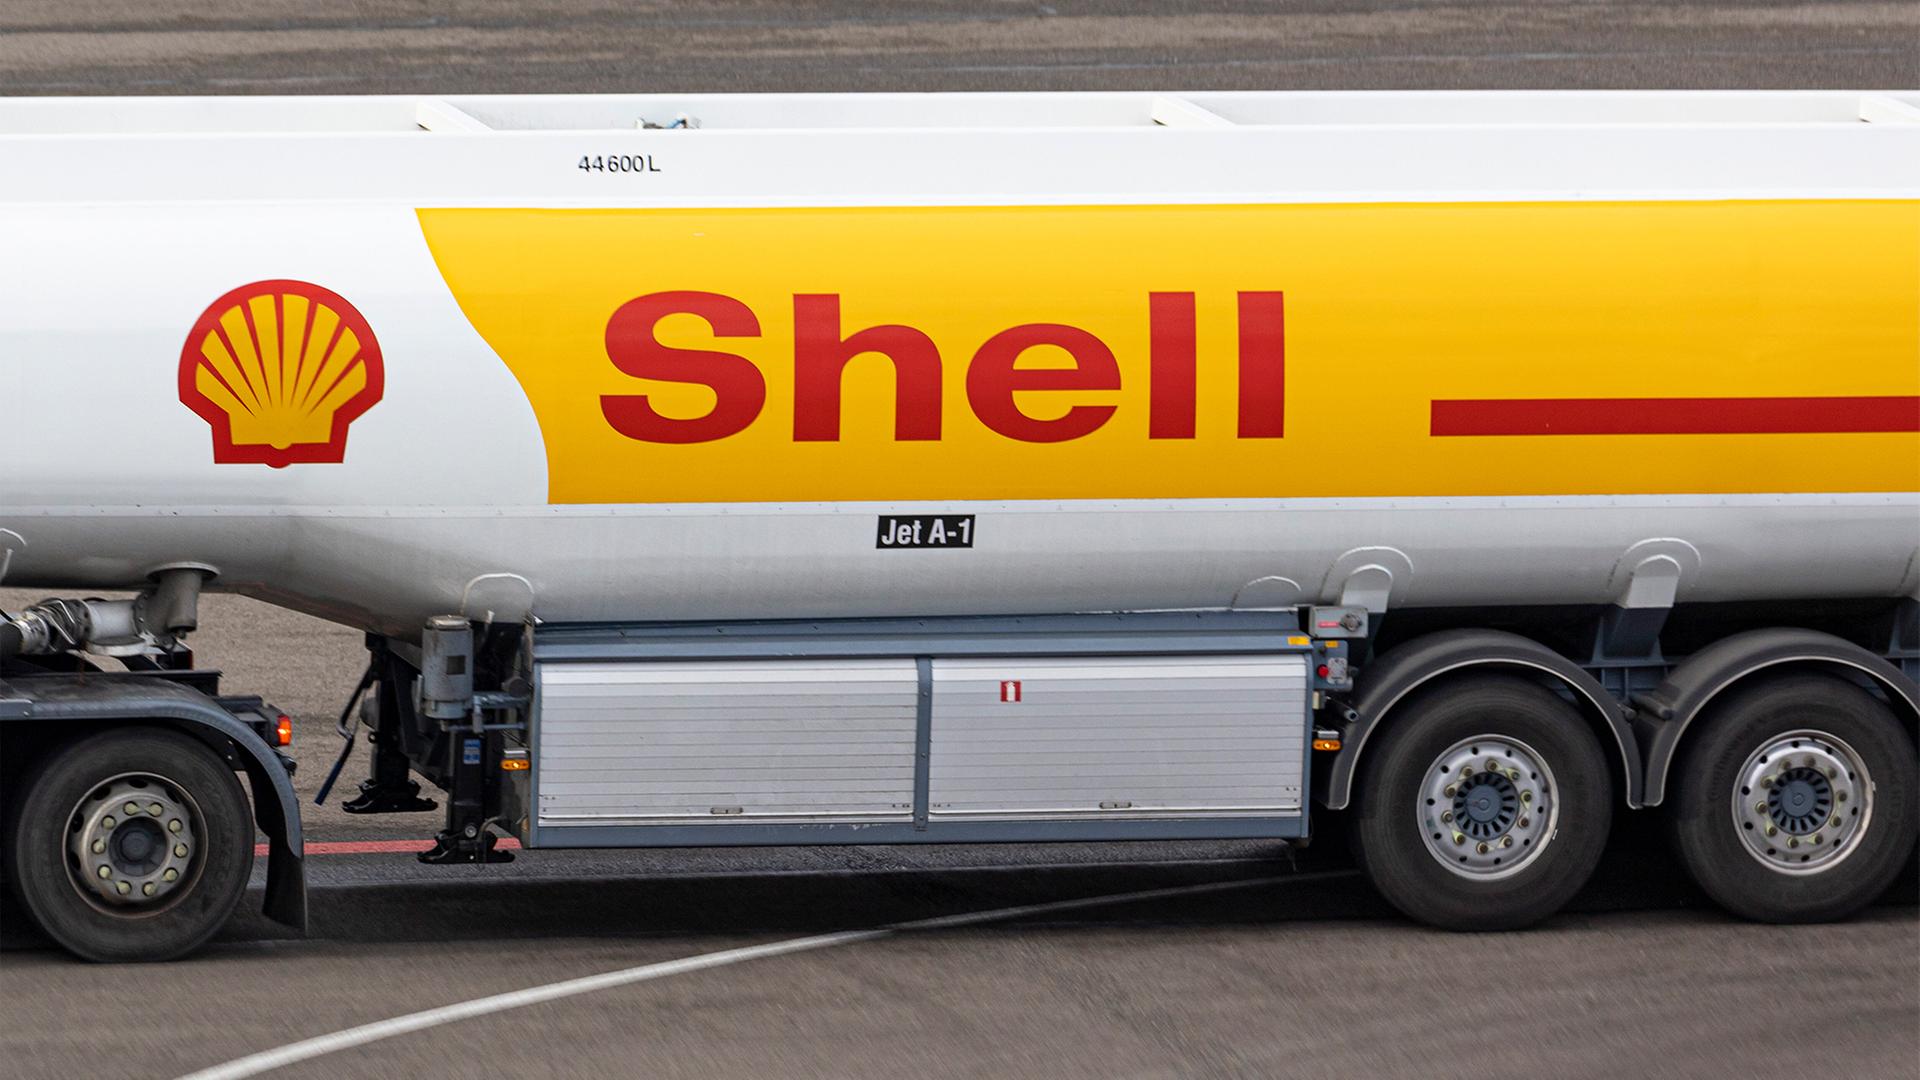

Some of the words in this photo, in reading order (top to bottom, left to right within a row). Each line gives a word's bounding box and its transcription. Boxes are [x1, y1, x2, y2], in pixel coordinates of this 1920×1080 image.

[600, 290, 1285, 444] Shell
[880, 518, 922, 545] Jet
[927, 518, 971, 545] A-1
